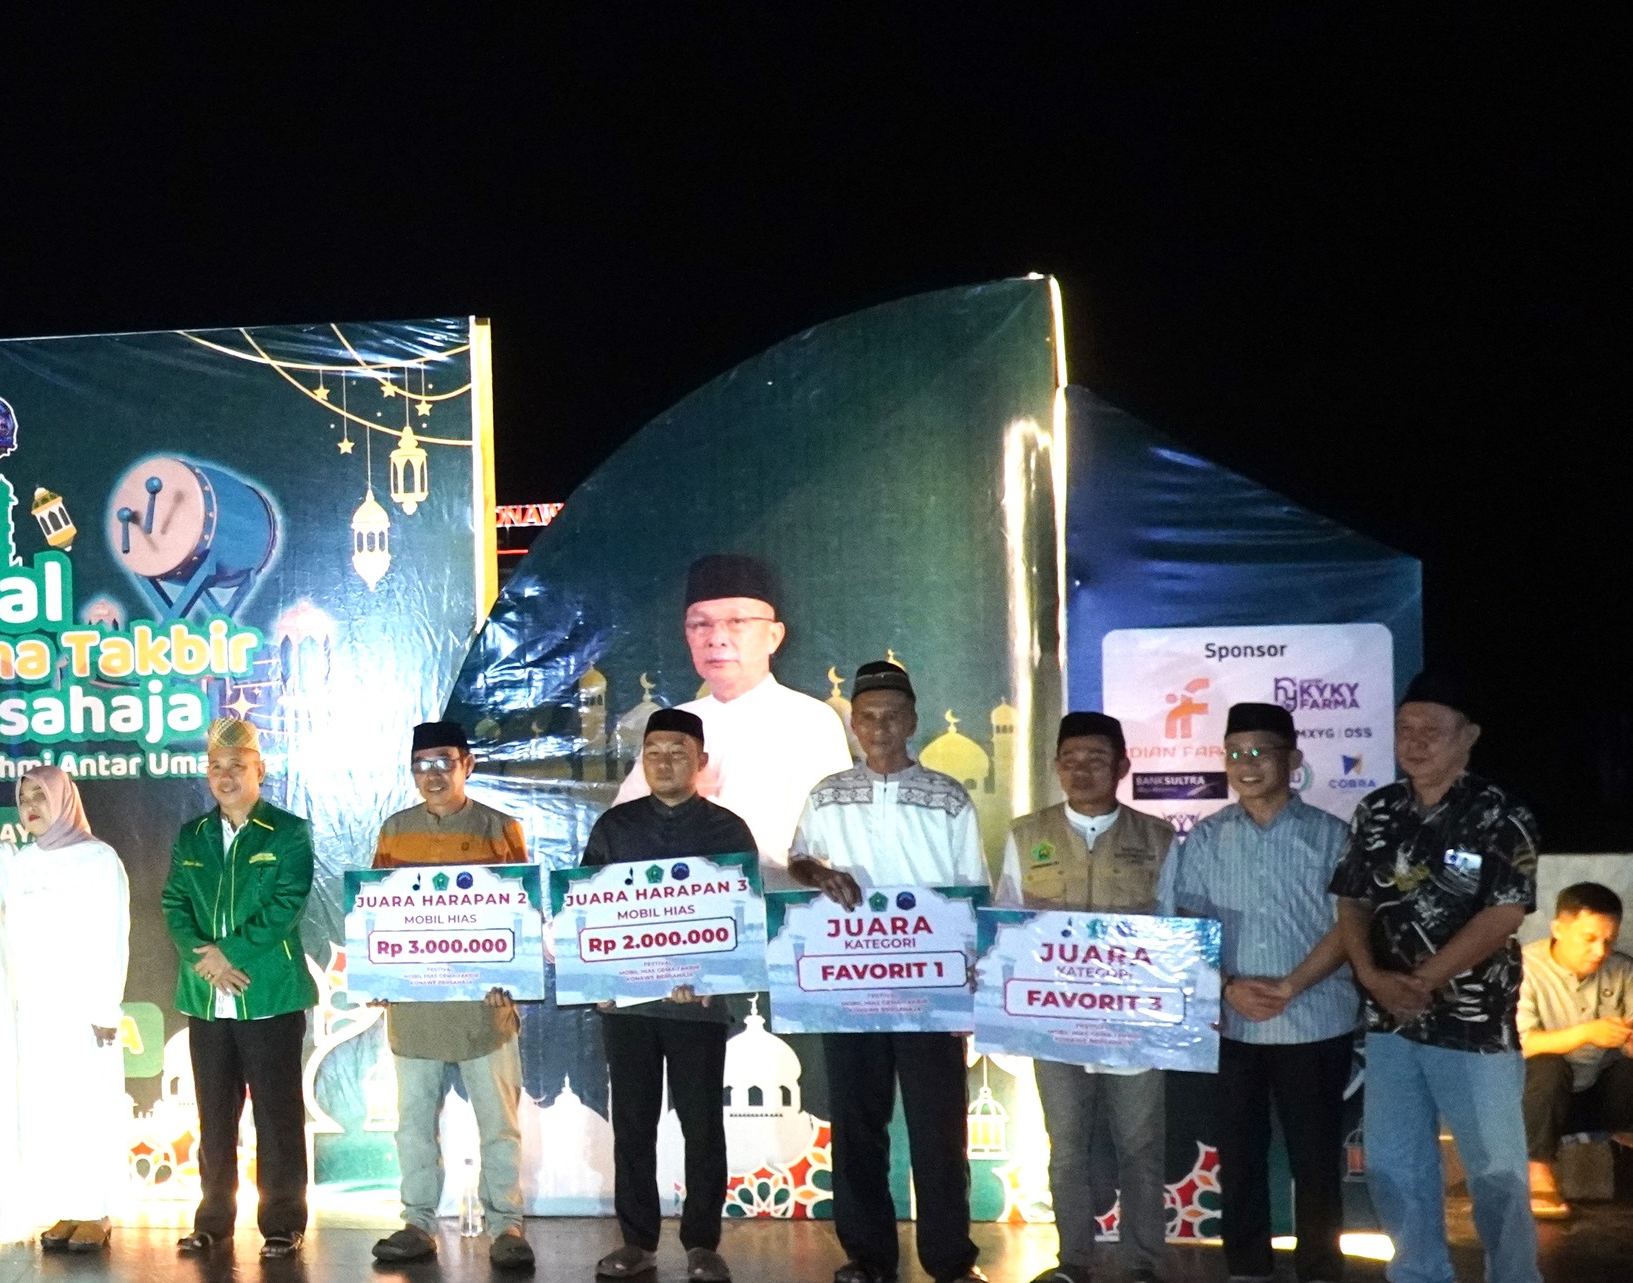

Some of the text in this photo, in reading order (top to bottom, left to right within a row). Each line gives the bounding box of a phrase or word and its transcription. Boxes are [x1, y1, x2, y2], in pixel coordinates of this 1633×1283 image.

[61, 620, 258, 677] Takbir
[1204, 642, 1287, 662] Sponsor
[1300, 683, 1359, 699] KYKY
[1300, 698, 1360, 710] FARMA
[1345, 727, 1372, 738] OSS
[1129, 745, 1224, 758] DIAN FAR
[61, 755, 142, 776] Antar
[149, 752, 209, 775] Uma
[1328, 779, 1376, 789] COBRA
[357, 892, 527, 908] JUARA HARAPAN 2
[565, 879, 748, 907] JUARA HARAPAN 3
[404, 914, 477, 925] MOBIL HIAS
[617, 905, 695, 921] MOBIL HIAS
[827, 916, 934, 938] JUARA
[377, 938, 507, 958] Rp 3.000.000
[588, 927, 729, 955] Rp 2.000.000
[844, 938, 916, 950] KATEGORI
[1040, 943, 1153, 966] JUARA
[821, 962, 944, 981] FAVORIT 1
[1056, 966, 1133, 979] KATEGOR
[1027, 990, 1163, 1011] FAVORIT 3
